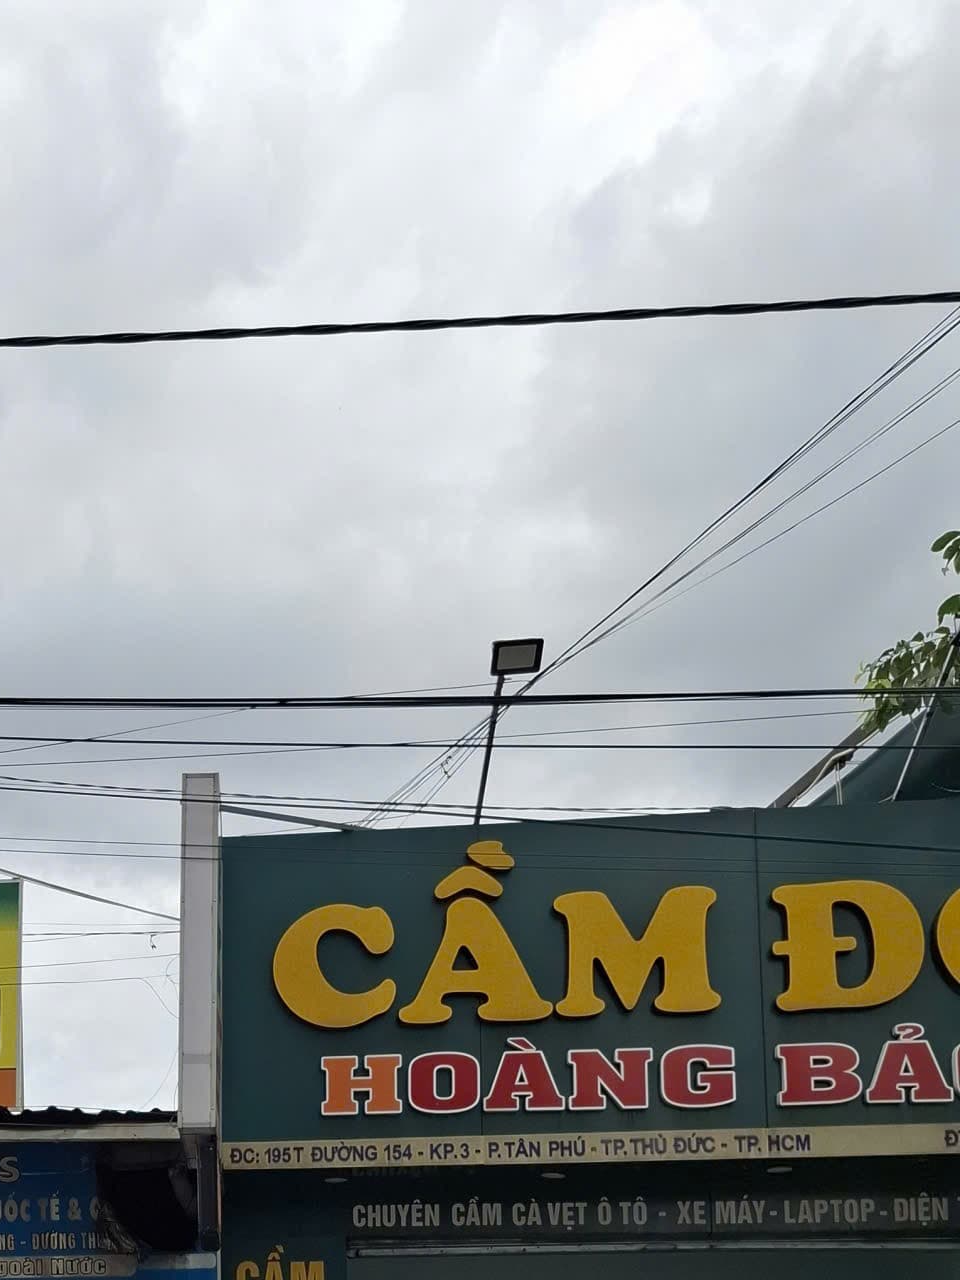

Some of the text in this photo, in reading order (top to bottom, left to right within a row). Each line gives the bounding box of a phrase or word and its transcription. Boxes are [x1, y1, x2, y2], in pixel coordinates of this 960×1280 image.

[273, 840, 960, 1028] CẦM Đ
[321, 1022, 960, 1115] HOÀNG BẢ
[230, 1148, 260, 1164] ĐC:
[265, 1147, 304, 1163] 195T
[311, 1141, 377, 1162] ĐƯỜNG
[384, 1144, 412, 1161] 154
[548, 1136, 586, 1157] PHÚ
[673, 1132, 716, 1153] ĐỨC
[734, 1136, 761, 1152] TP.
[768, 1134, 811, 1151] HCM
[38, 1191, 60, 1221] TẾ
[68, 1198, 82, 1221] &
[352, 1199, 440, 1228] CHUYÊN
[451, 1196, 502, 1227] CẦM
[512, 1198, 540, 1226] CÀ
[548, 1202, 587, 1231] VẸT
[597, 1197, 612, 1225] Ô
[619, 1196, 648, 1225] TÔ
[677, 1201, 706, 1225] XE
[50, 1257, 107, 1275] Nước
